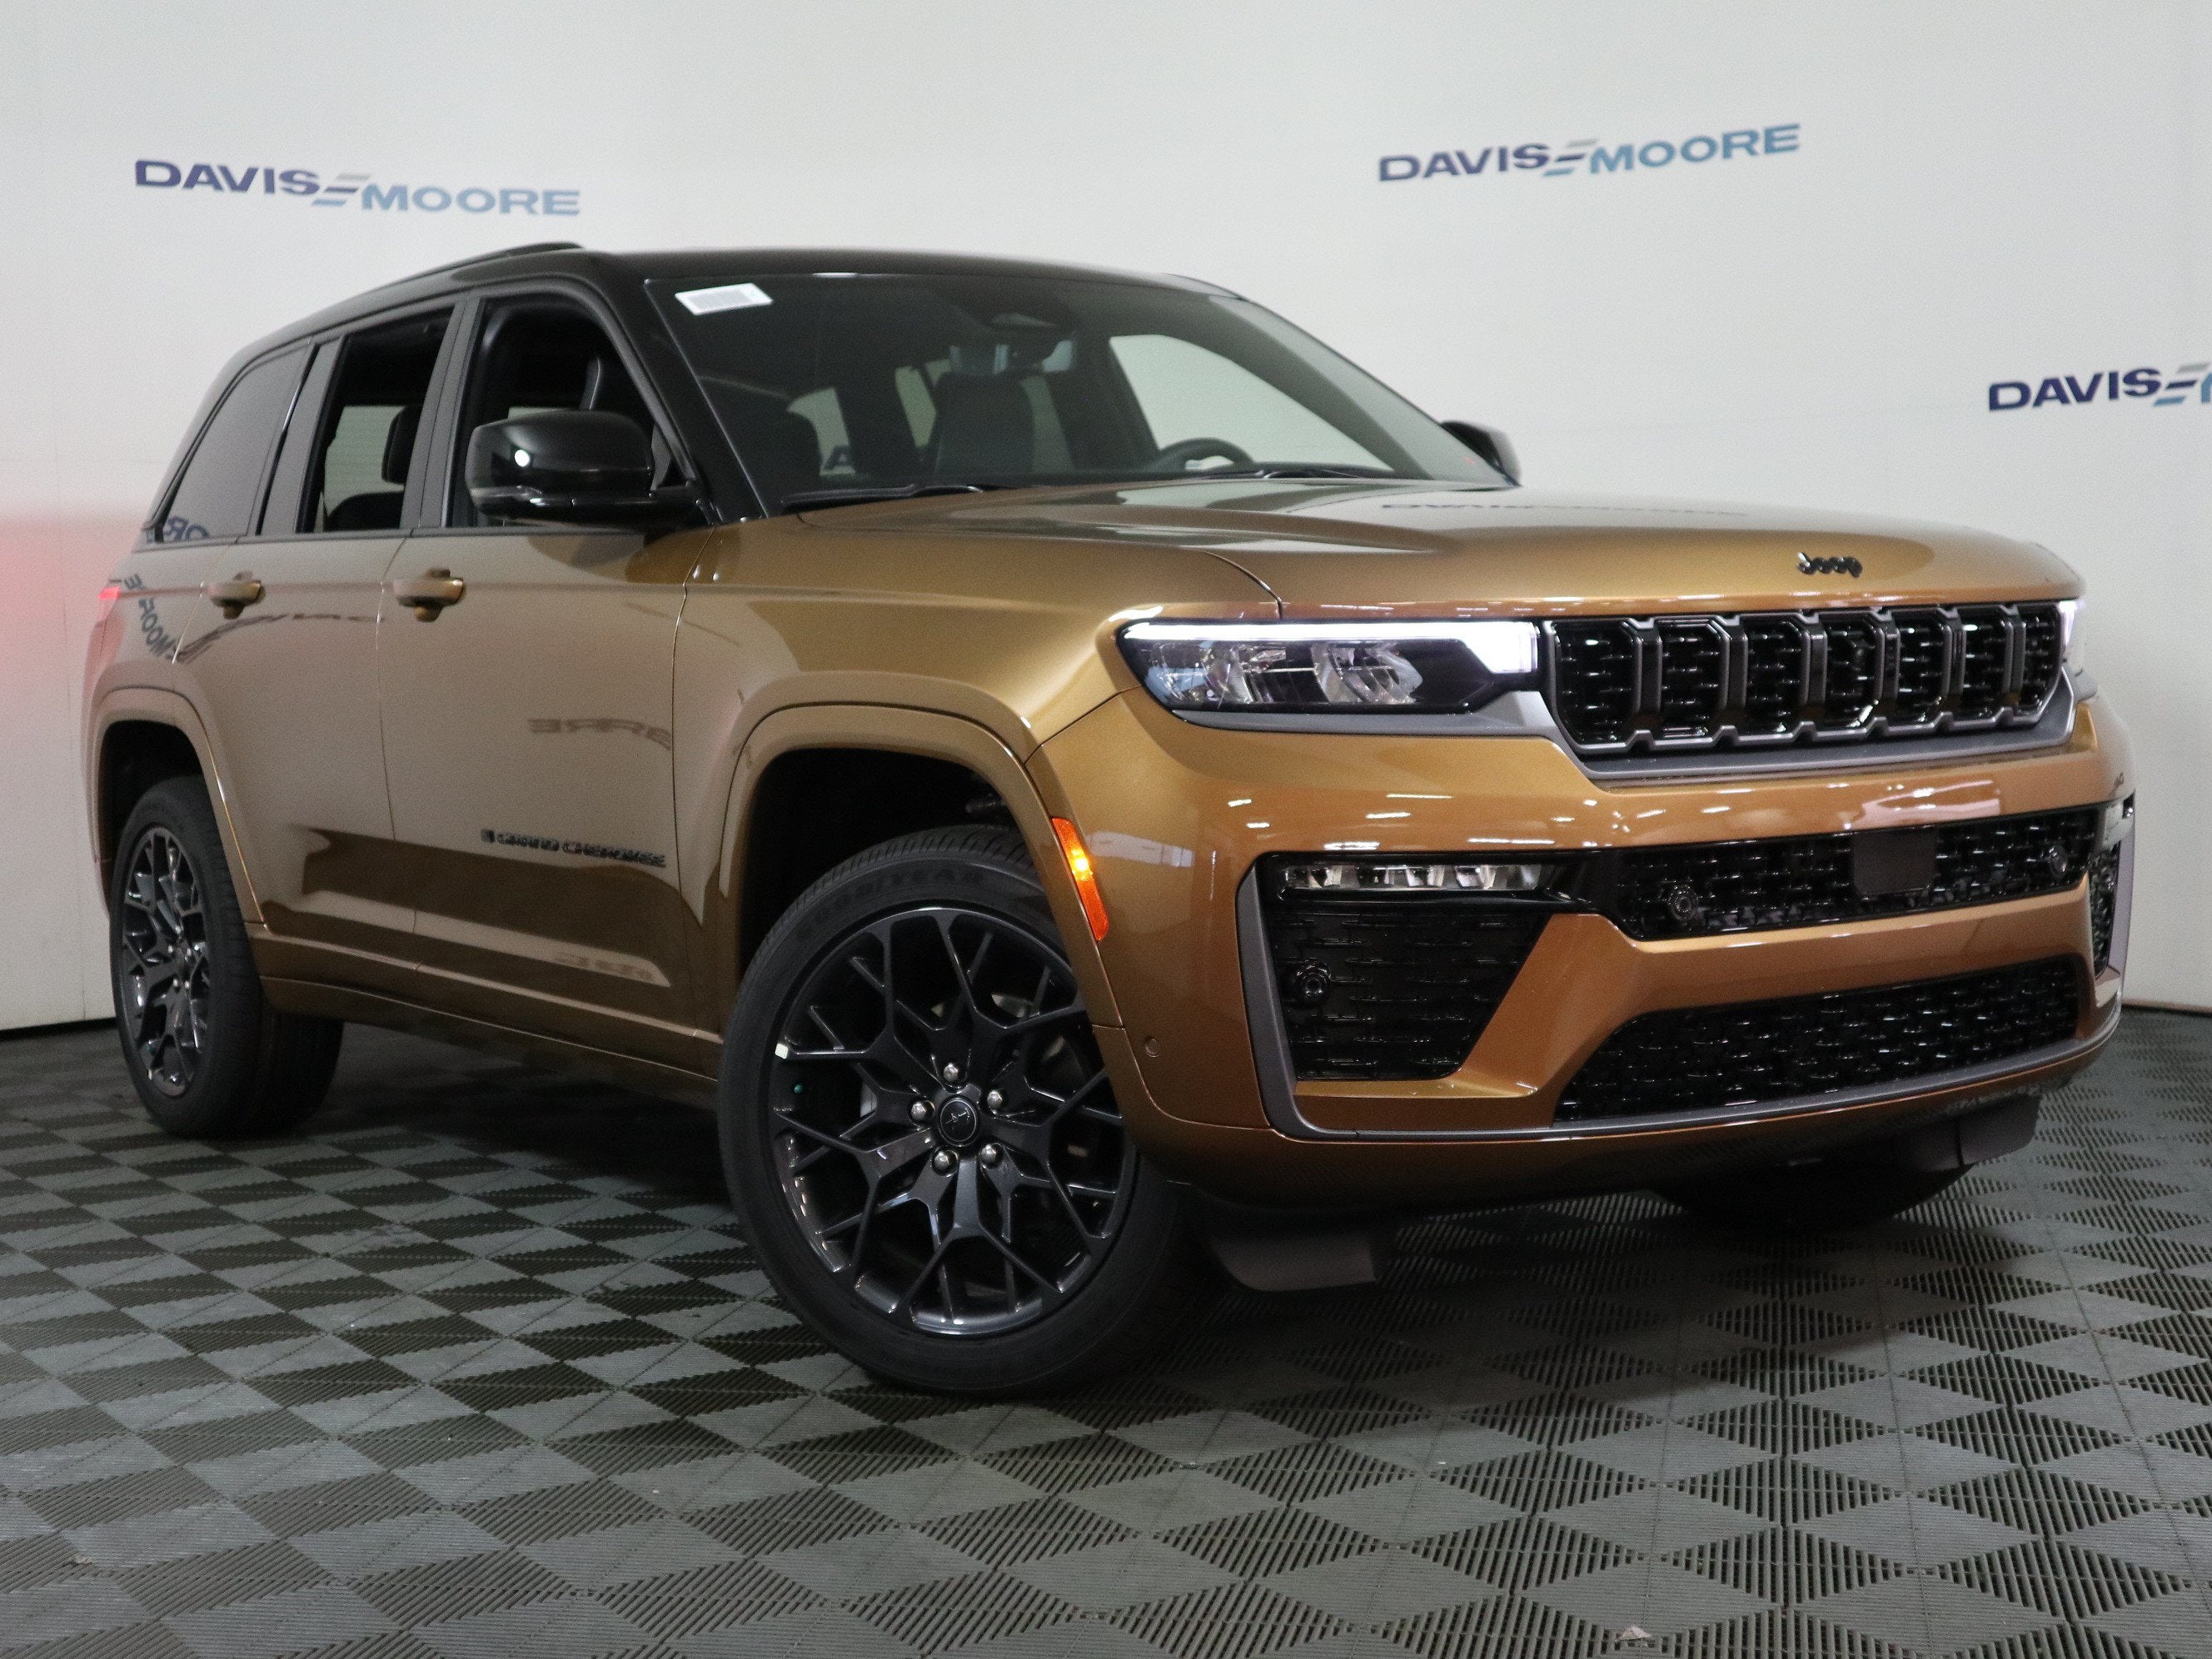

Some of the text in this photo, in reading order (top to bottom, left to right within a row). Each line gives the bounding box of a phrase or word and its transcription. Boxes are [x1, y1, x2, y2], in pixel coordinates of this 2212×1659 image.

[1378, 122, 1801, 182] DAVIS MOORE
[134, 159, 580, 216] DAVIS MOORE
[1988, 366, 2163, 411] DAVIS
[1796, 552, 1863, 578] Jeep
[496, 833, 560, 852] GRAND
